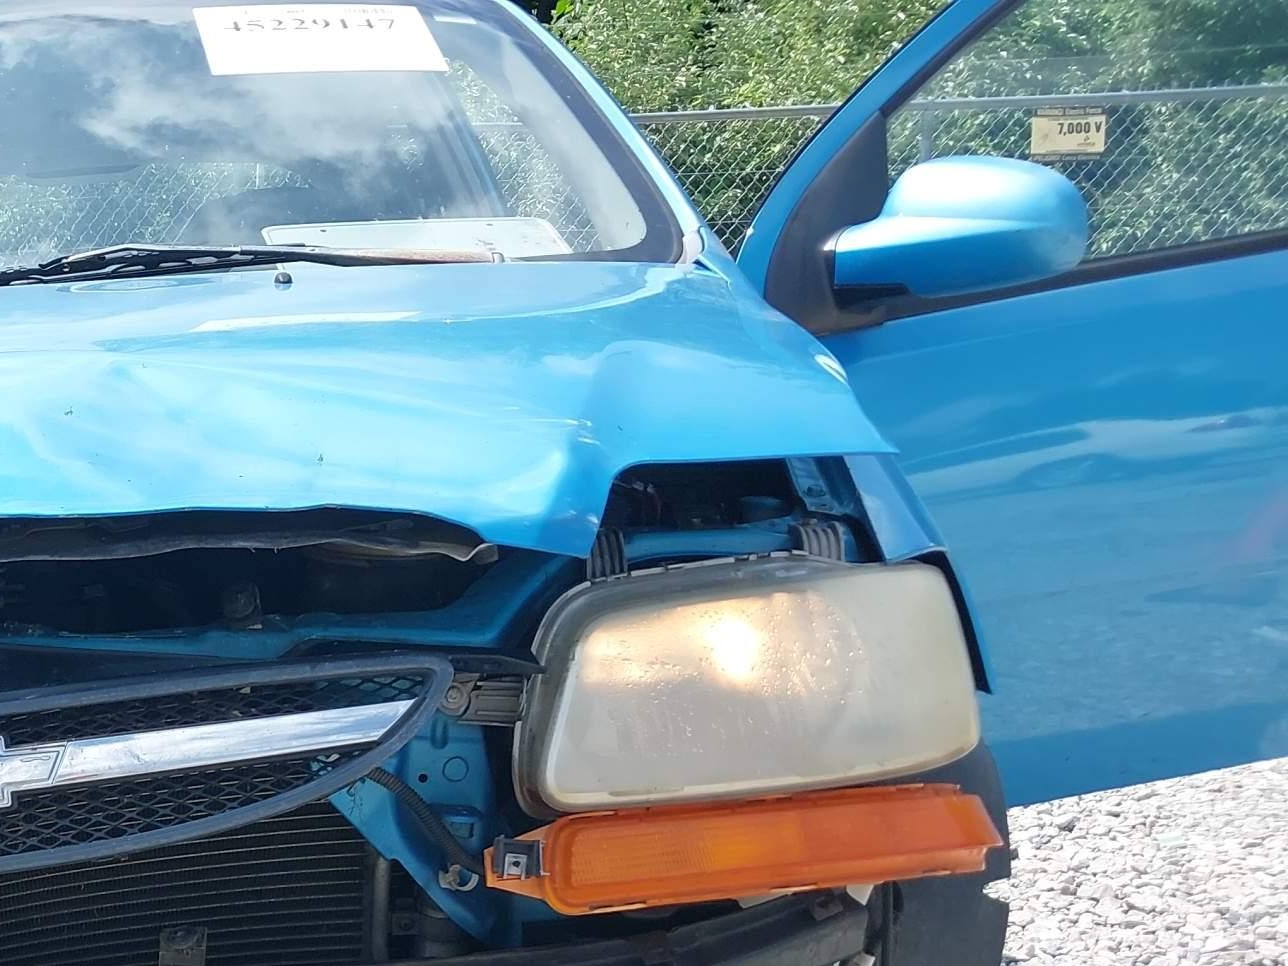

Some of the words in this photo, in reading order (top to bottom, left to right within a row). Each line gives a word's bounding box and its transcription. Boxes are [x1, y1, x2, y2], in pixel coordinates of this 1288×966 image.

[223, 18, 395, 32] 45229147
[1057, 122, 1091, 136] 7,000
[1094, 121, 1103, 134] V
